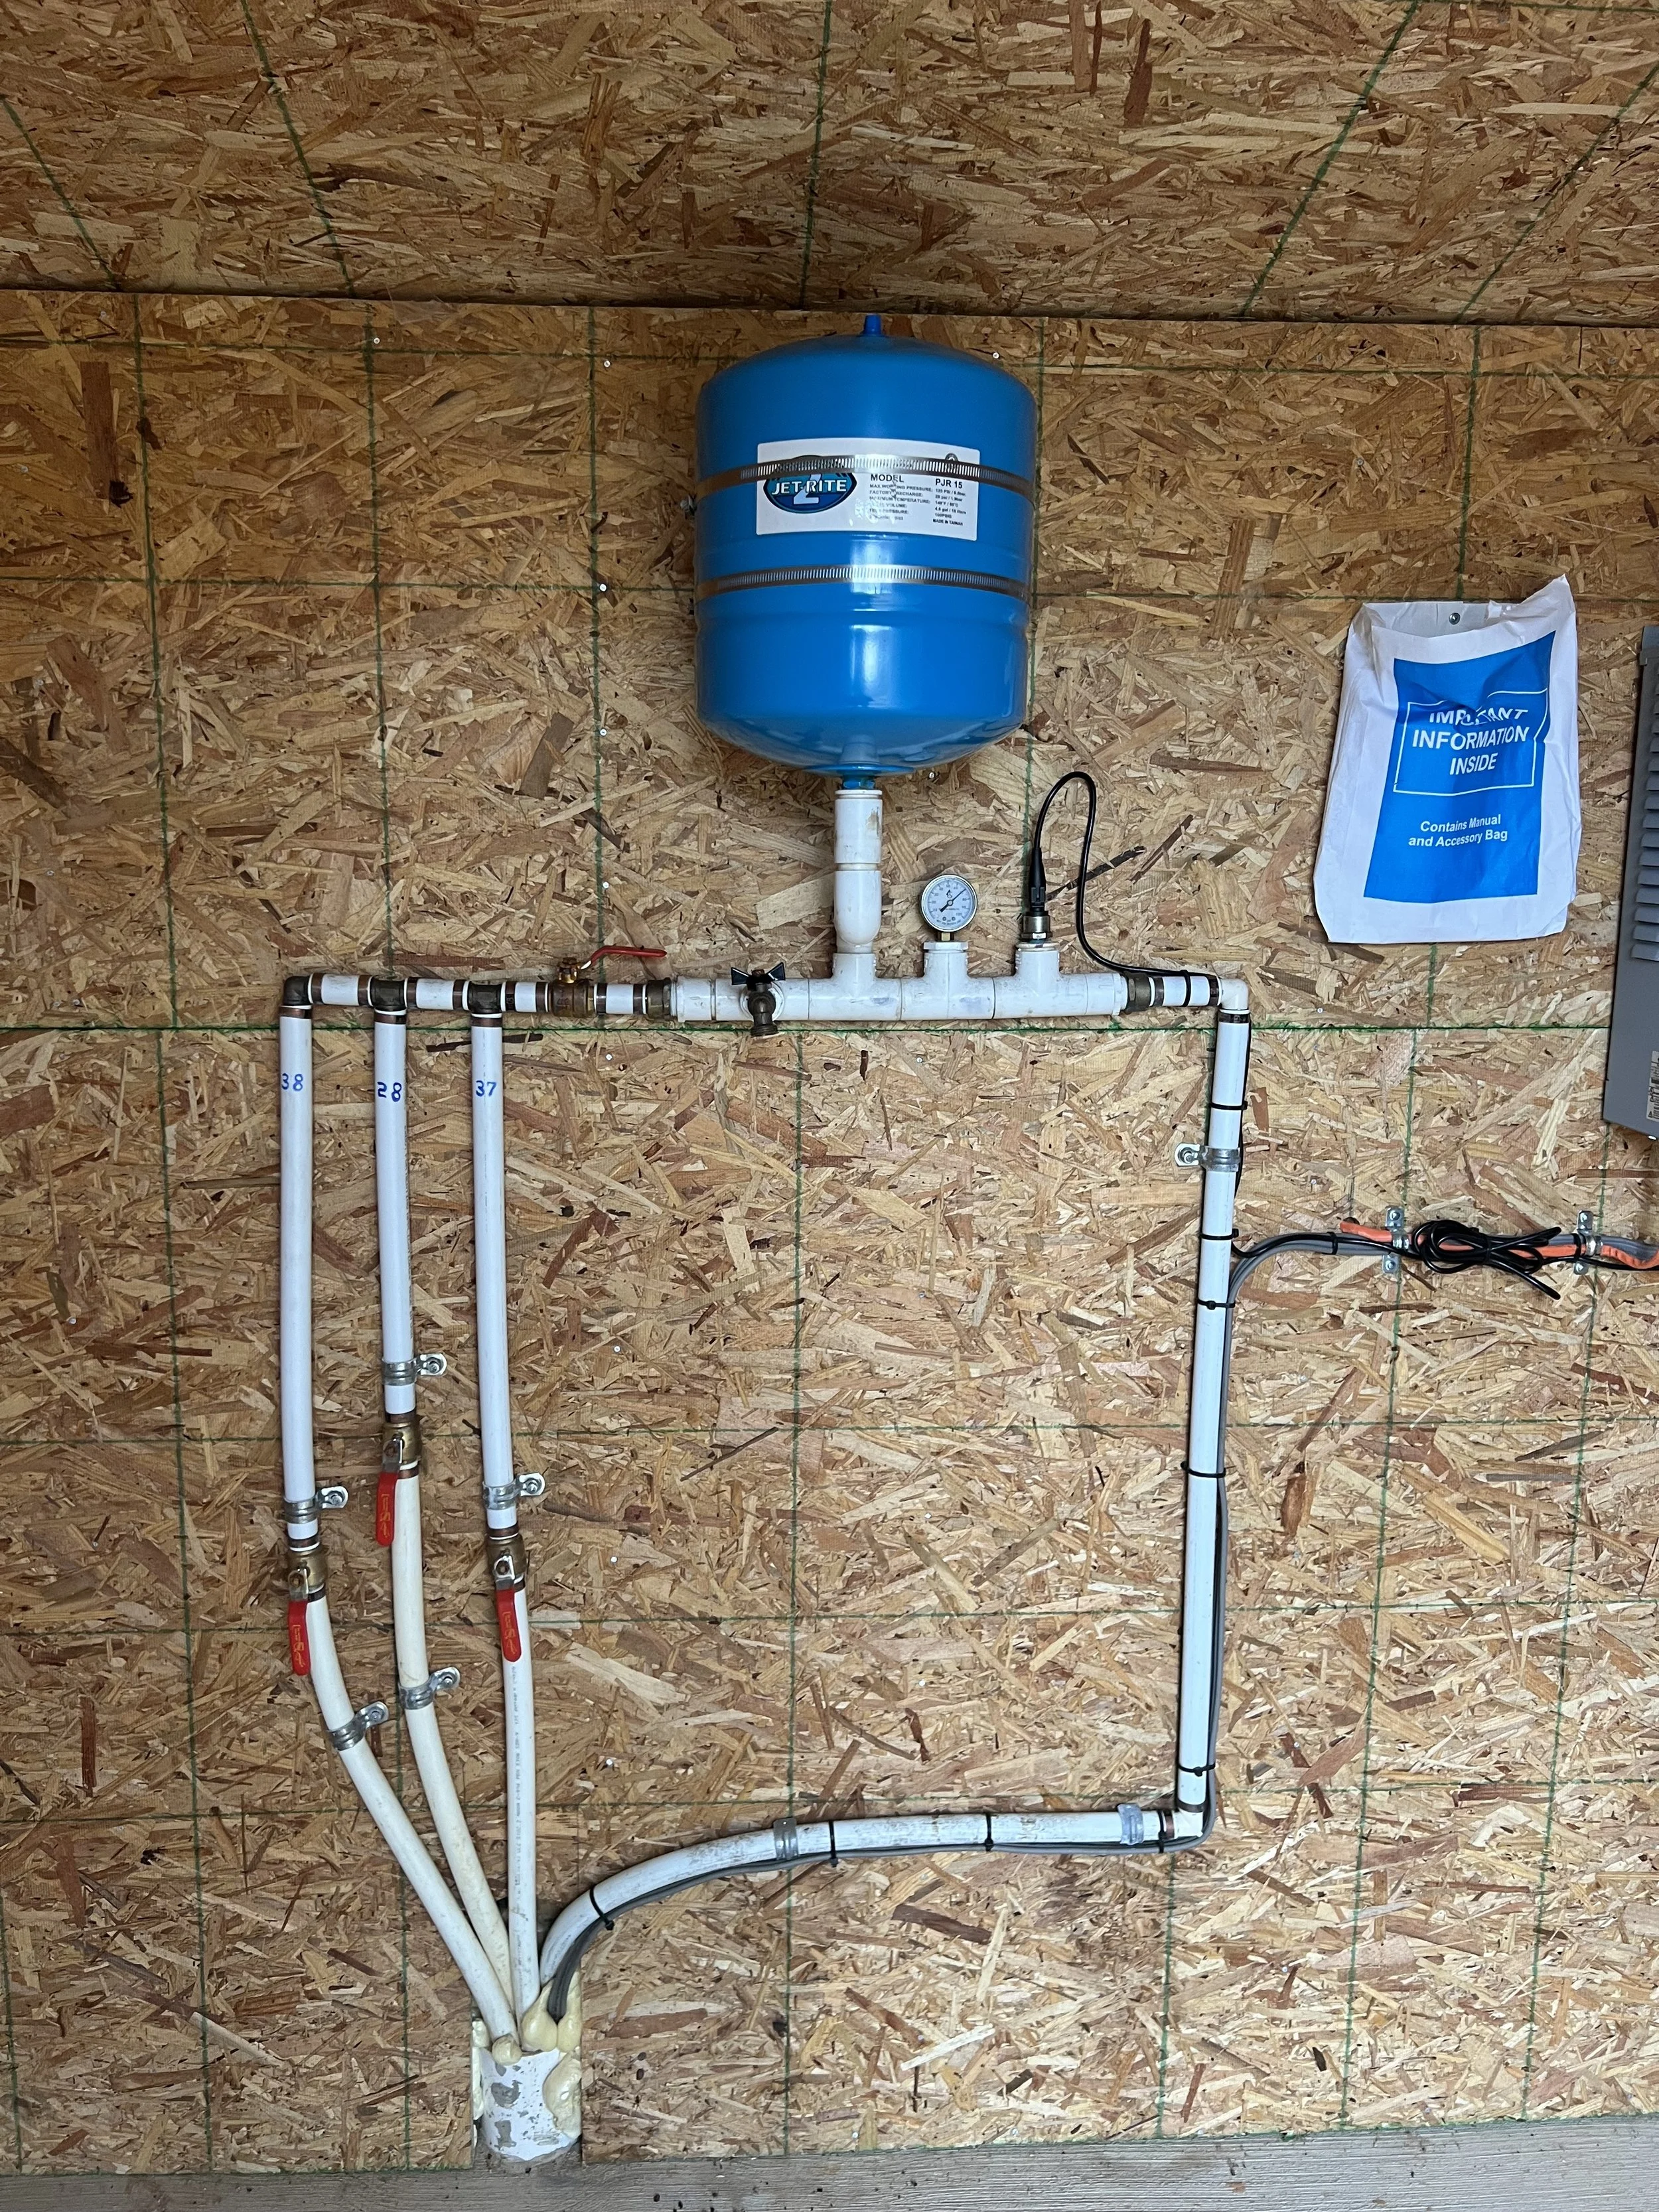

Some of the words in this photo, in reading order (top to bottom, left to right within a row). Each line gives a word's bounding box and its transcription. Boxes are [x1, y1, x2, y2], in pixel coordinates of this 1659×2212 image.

[771, 479, 847, 495] JET-RITE
[870, 474, 904, 483] MODEL
[935, 478, 952, 487] PJR
[954, 480, 963, 489] 15
[1411, 725, 1530, 751] INFORMATION
[1449, 753, 1498, 776] INSIDE
[1420, 820, 1467, 832] Contains
[1469, 814, 1501, 829] Manual
[1408, 836, 1433, 847] and
[1435, 832, 1483, 847] Accessory
[1485, 829, 1508, 842] Bag
[281, 1072, 304, 1092] 38
[475, 1080, 498, 1097] 37
[377, 1081, 403, 1102] 28
